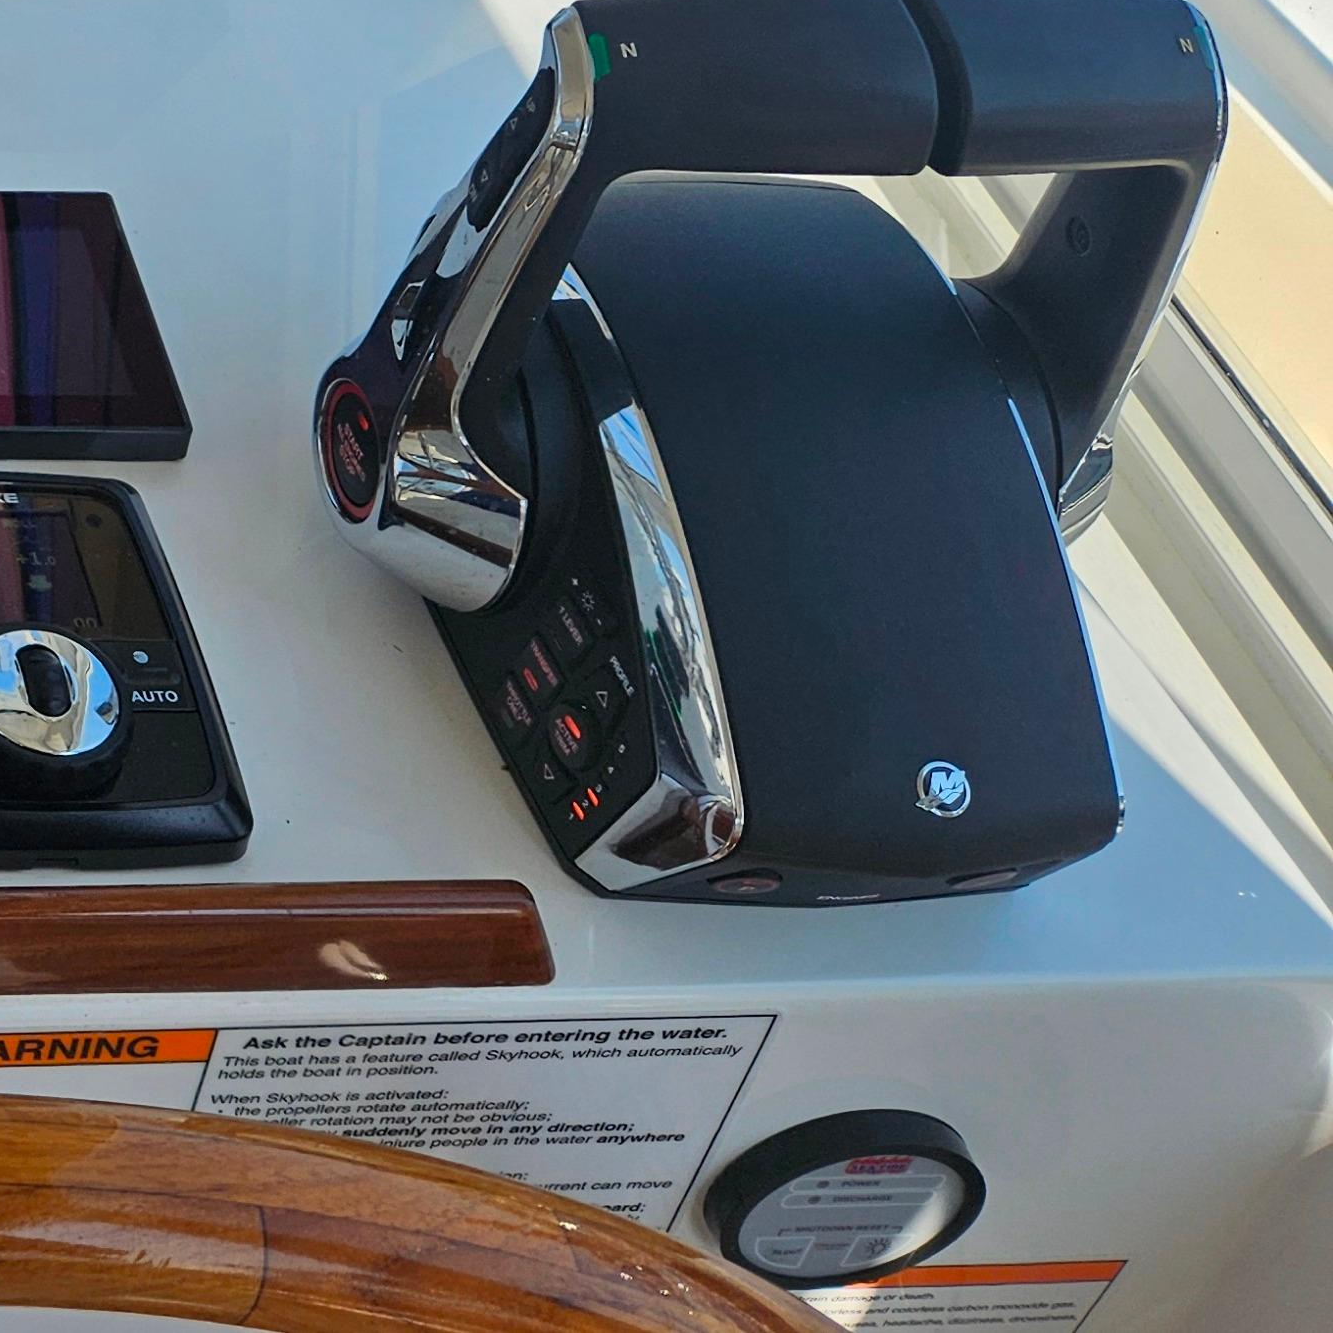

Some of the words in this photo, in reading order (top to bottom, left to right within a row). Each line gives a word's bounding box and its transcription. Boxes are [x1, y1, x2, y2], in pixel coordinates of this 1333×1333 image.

[619, 41, 638, 60] N
[1180, 37, 1194, 53] N
[609, 655, 635, 697] PROFILE
[131, 689, 179, 703] AUTO
[243, 1036, 289, 1049] Ask
[295, 1035, 332, 1048] the
[339, 1032, 426, 1049] Captain
[433, 1031, 508, 1045] before
[514, 1029, 610, 1044] entering
[617, 1028, 655, 1041] the
[661, 1027, 727, 1040] water.
[223, 1055, 260, 1067] This
[264, 1054, 303, 1066] boat
[308, 1054, 340, 1065] has
[345, 1055, 356, 1064] a
[362, 1053, 423, 1064] feature
[428, 1050, 481, 1062] called
[485, 1048, 565, 1062] Skyhook,
[572, 1047, 621, 1058] which
[627, 1044, 743, 1057] automatically
[218, 1068, 265, 1079] holds
[270, 1068, 297, 1078] the
[302, 1066, 342, 1077] boat
[346, 1065, 362, 1076] in
[365, 1064, 438, 1078] position.
[211, 1093, 260, 1104] When
[265, 1091, 342, 1105] Skyhook
[346, 1091, 360, 1101] is
[365, 1089, 449, 1101] activated:
[235, 1106, 261, 1116] the
[265, 1104, 351, 1118] propellers
[356, 1102, 406, 1113] rotate
[411, 1099, 530, 1113] automatically;
[342, 1124, 426, 1137] suddenly
[431, 1126, 482, 1136] move
[486, 1124, 504, 1134] in
[509, 1124, 543, 1137] any
[547, 1122, 635, 1133] direction;
